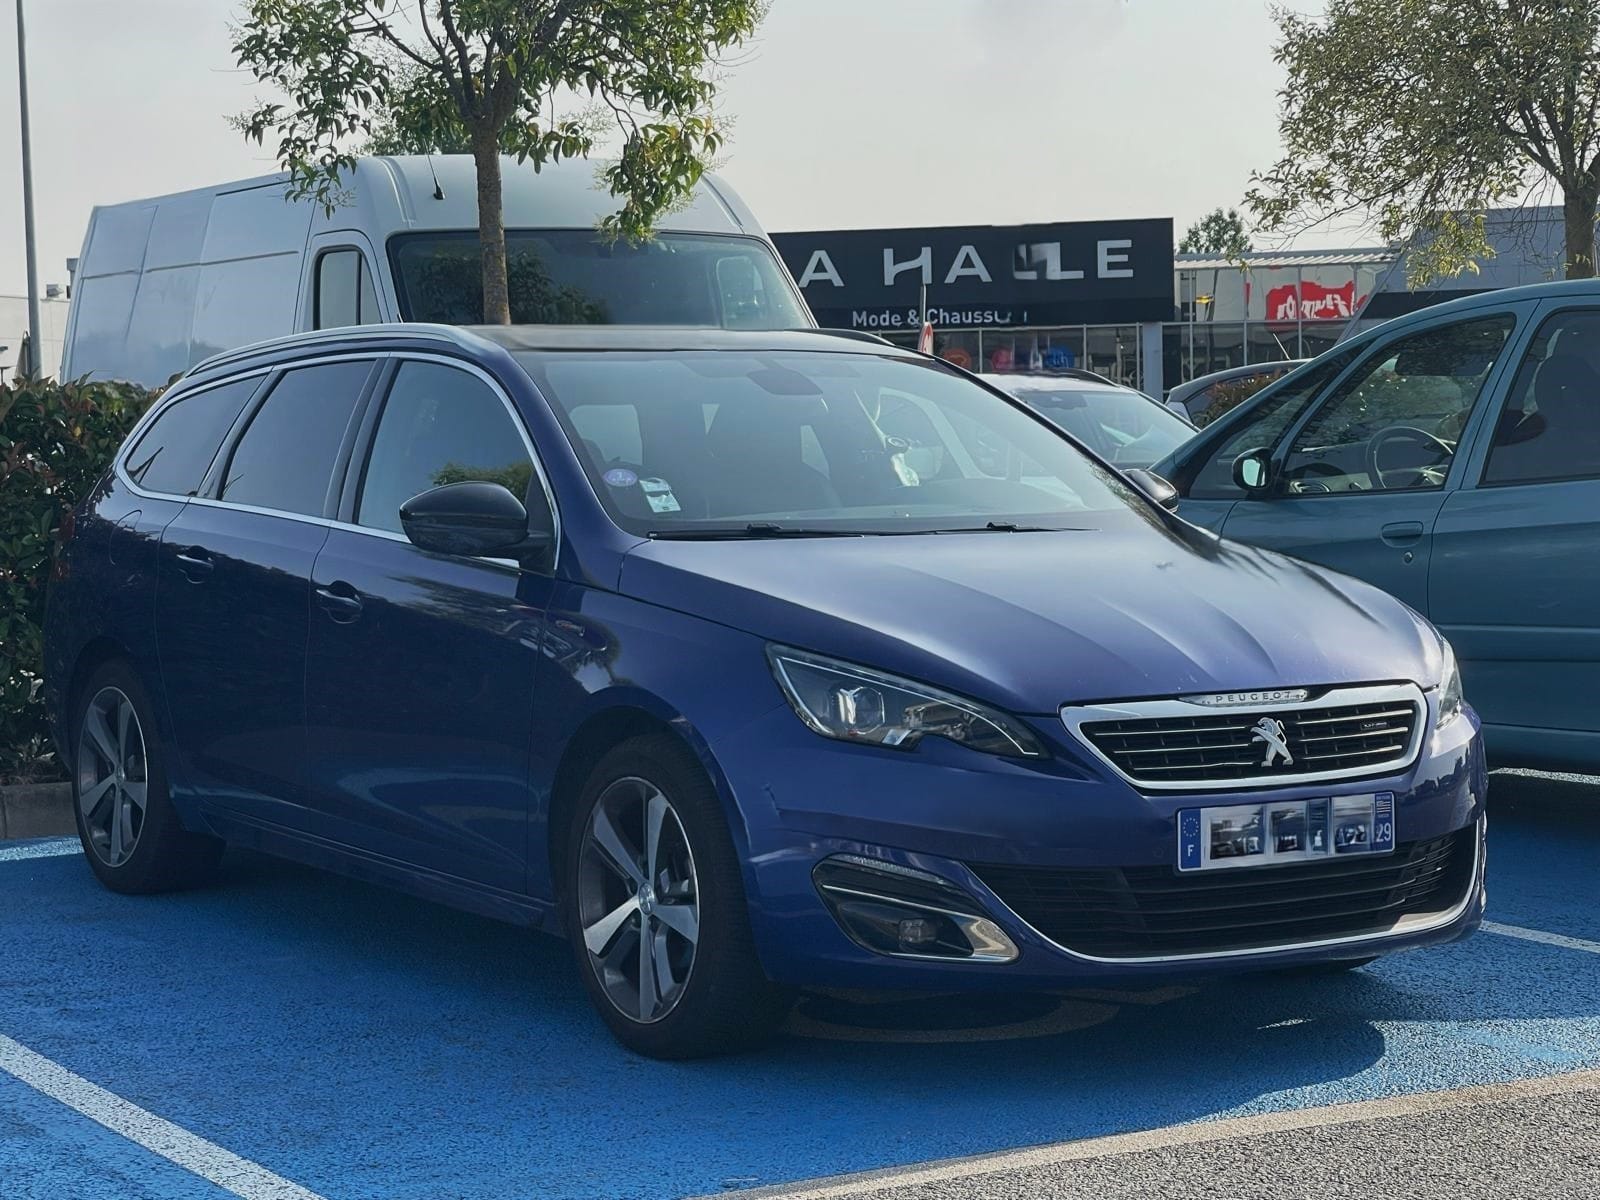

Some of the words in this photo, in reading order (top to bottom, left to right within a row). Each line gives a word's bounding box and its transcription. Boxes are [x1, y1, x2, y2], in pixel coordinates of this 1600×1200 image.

[798, 249, 845, 288] A
[852, 310, 902, 327] Mode
[907, 308, 920, 326] &
[1215, 690, 1291, 703] PEUGEOT
[1187, 844, 1195, 857] F
